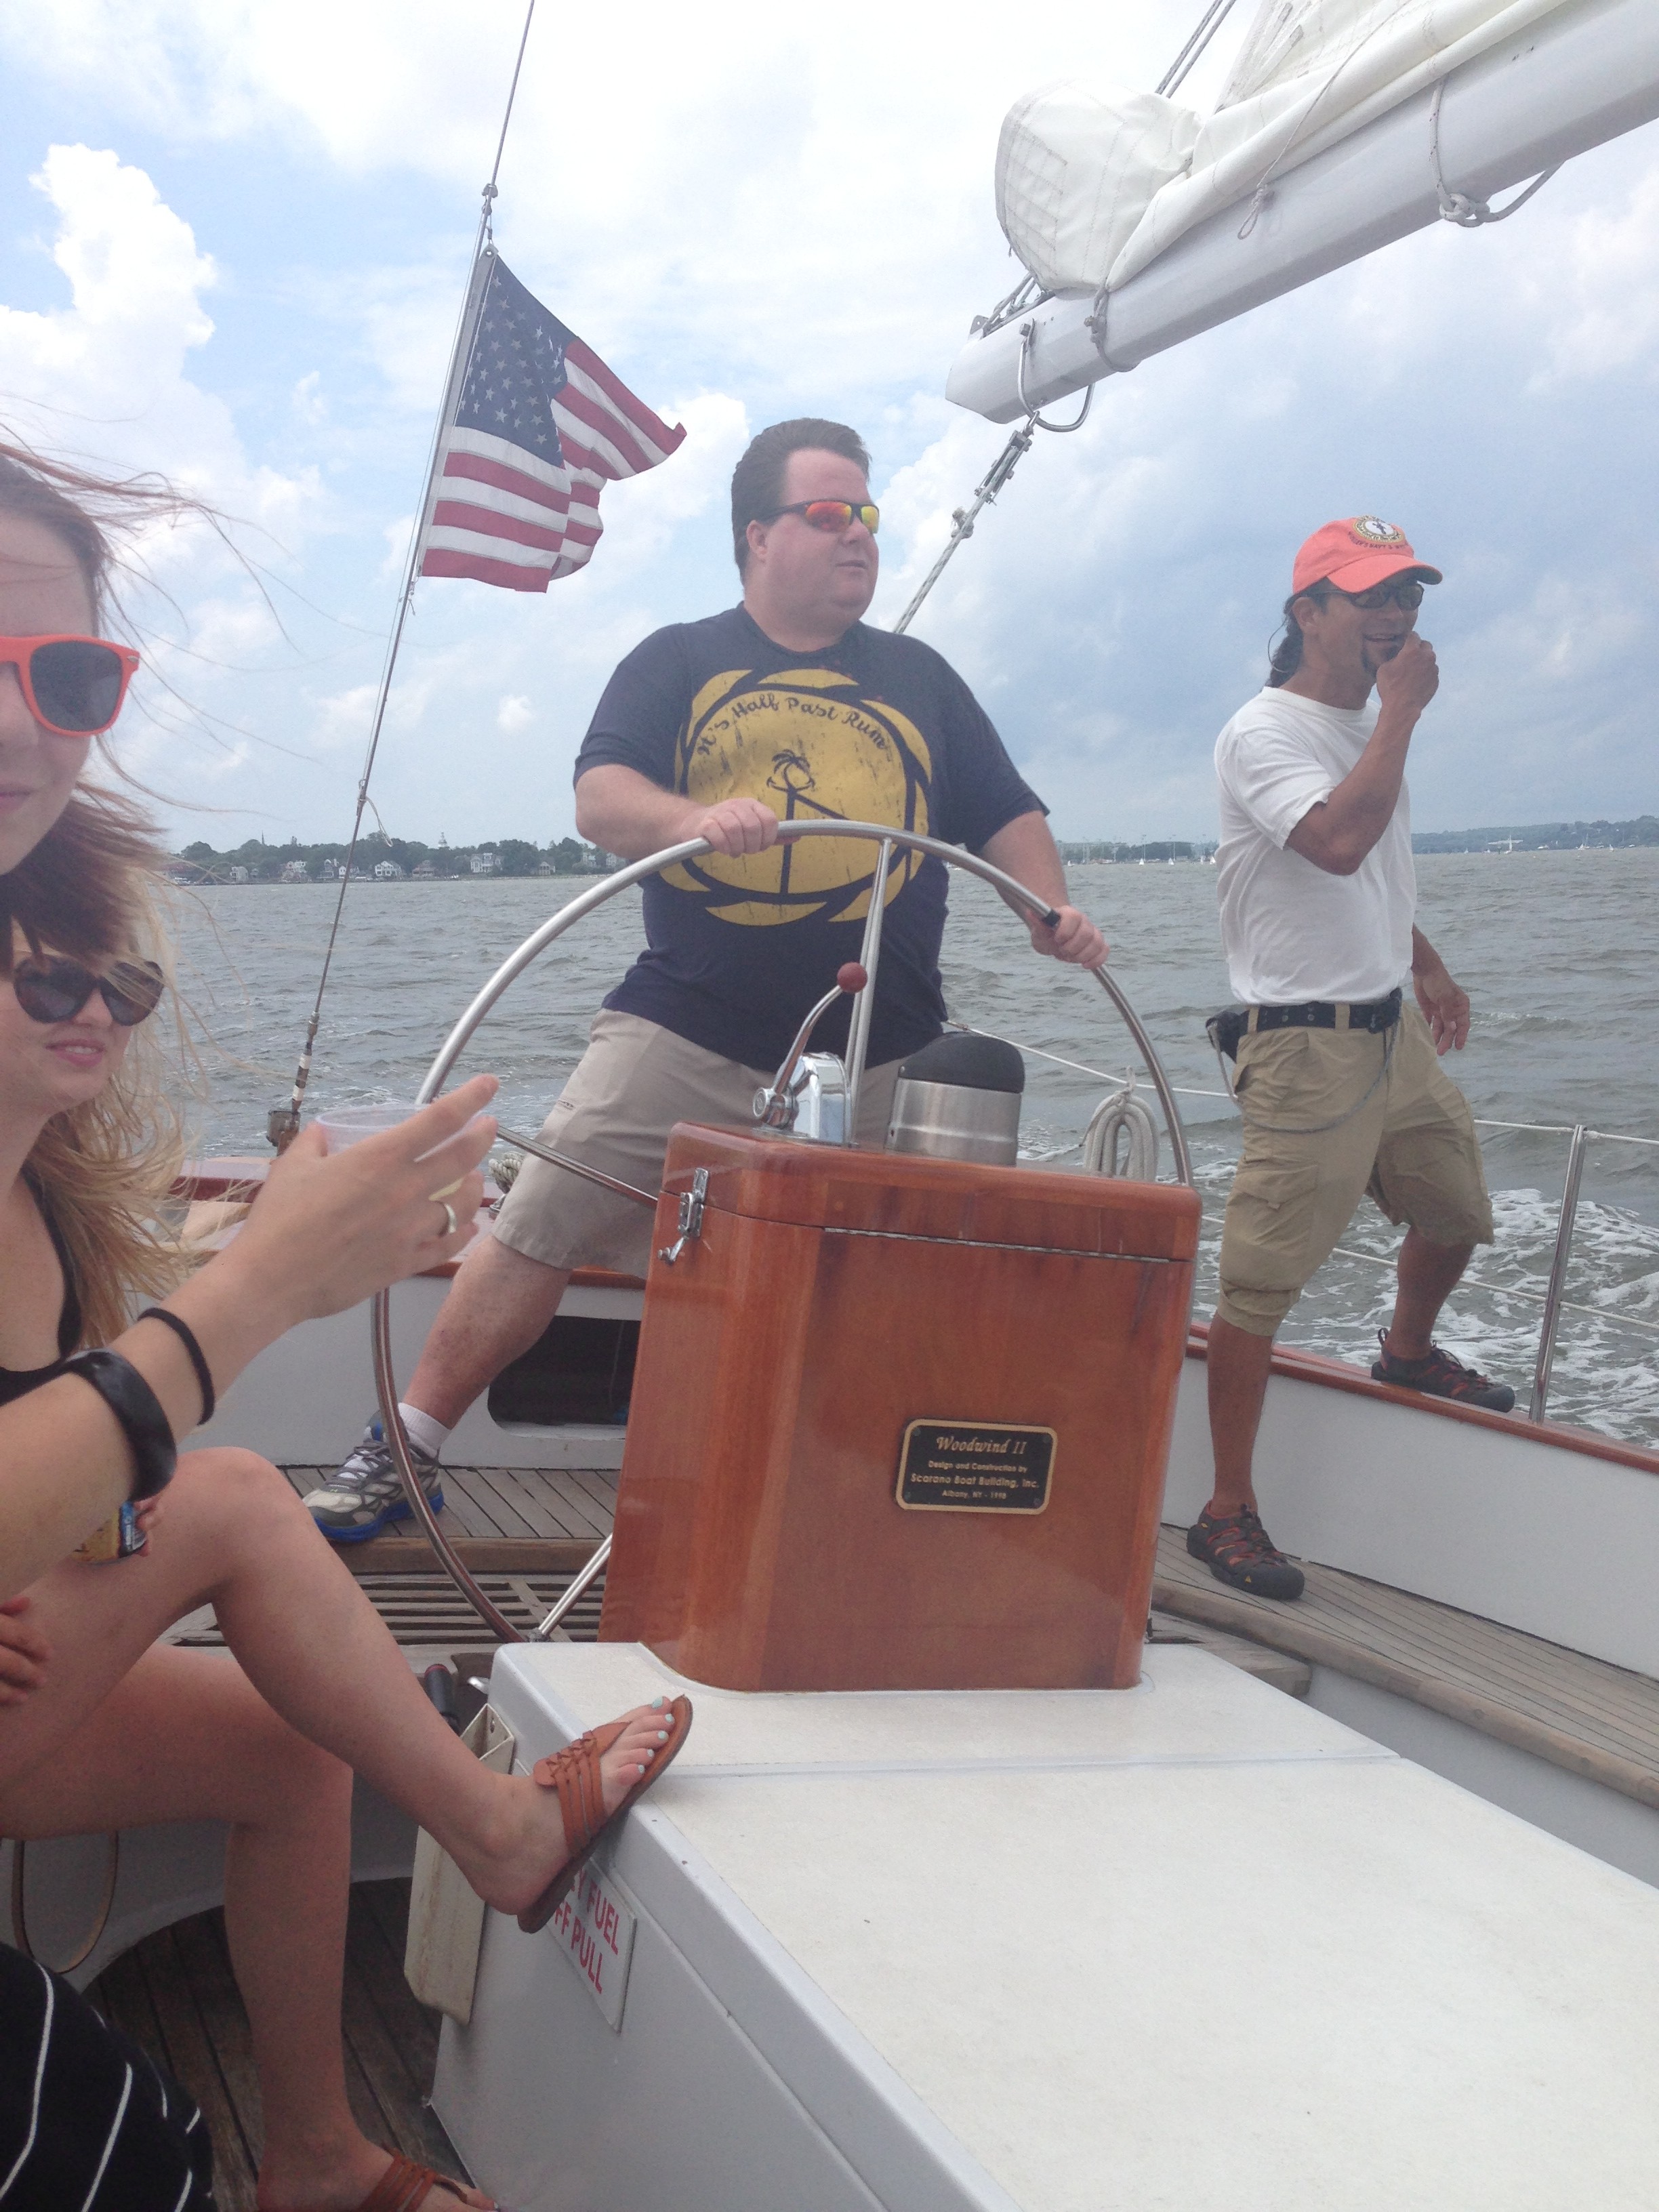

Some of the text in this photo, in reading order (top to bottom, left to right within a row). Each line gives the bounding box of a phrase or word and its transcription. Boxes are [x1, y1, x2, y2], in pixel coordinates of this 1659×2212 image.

[731, 693, 779, 718] Half
[785, 697, 838, 720] Past
[936, 1436, 1027, 1455] Woodwind II
[928, 1460, 954, 1470] Design
[955, 1462, 969, 1470] and
[971, 1462, 1016, 1472] Construction
[910, 1473, 951, 1484] Scarano
[954, 1475, 976, 1486] Boat
[587, 1879, 619, 1955] FUEL
[571, 1915, 603, 1994] PULL
